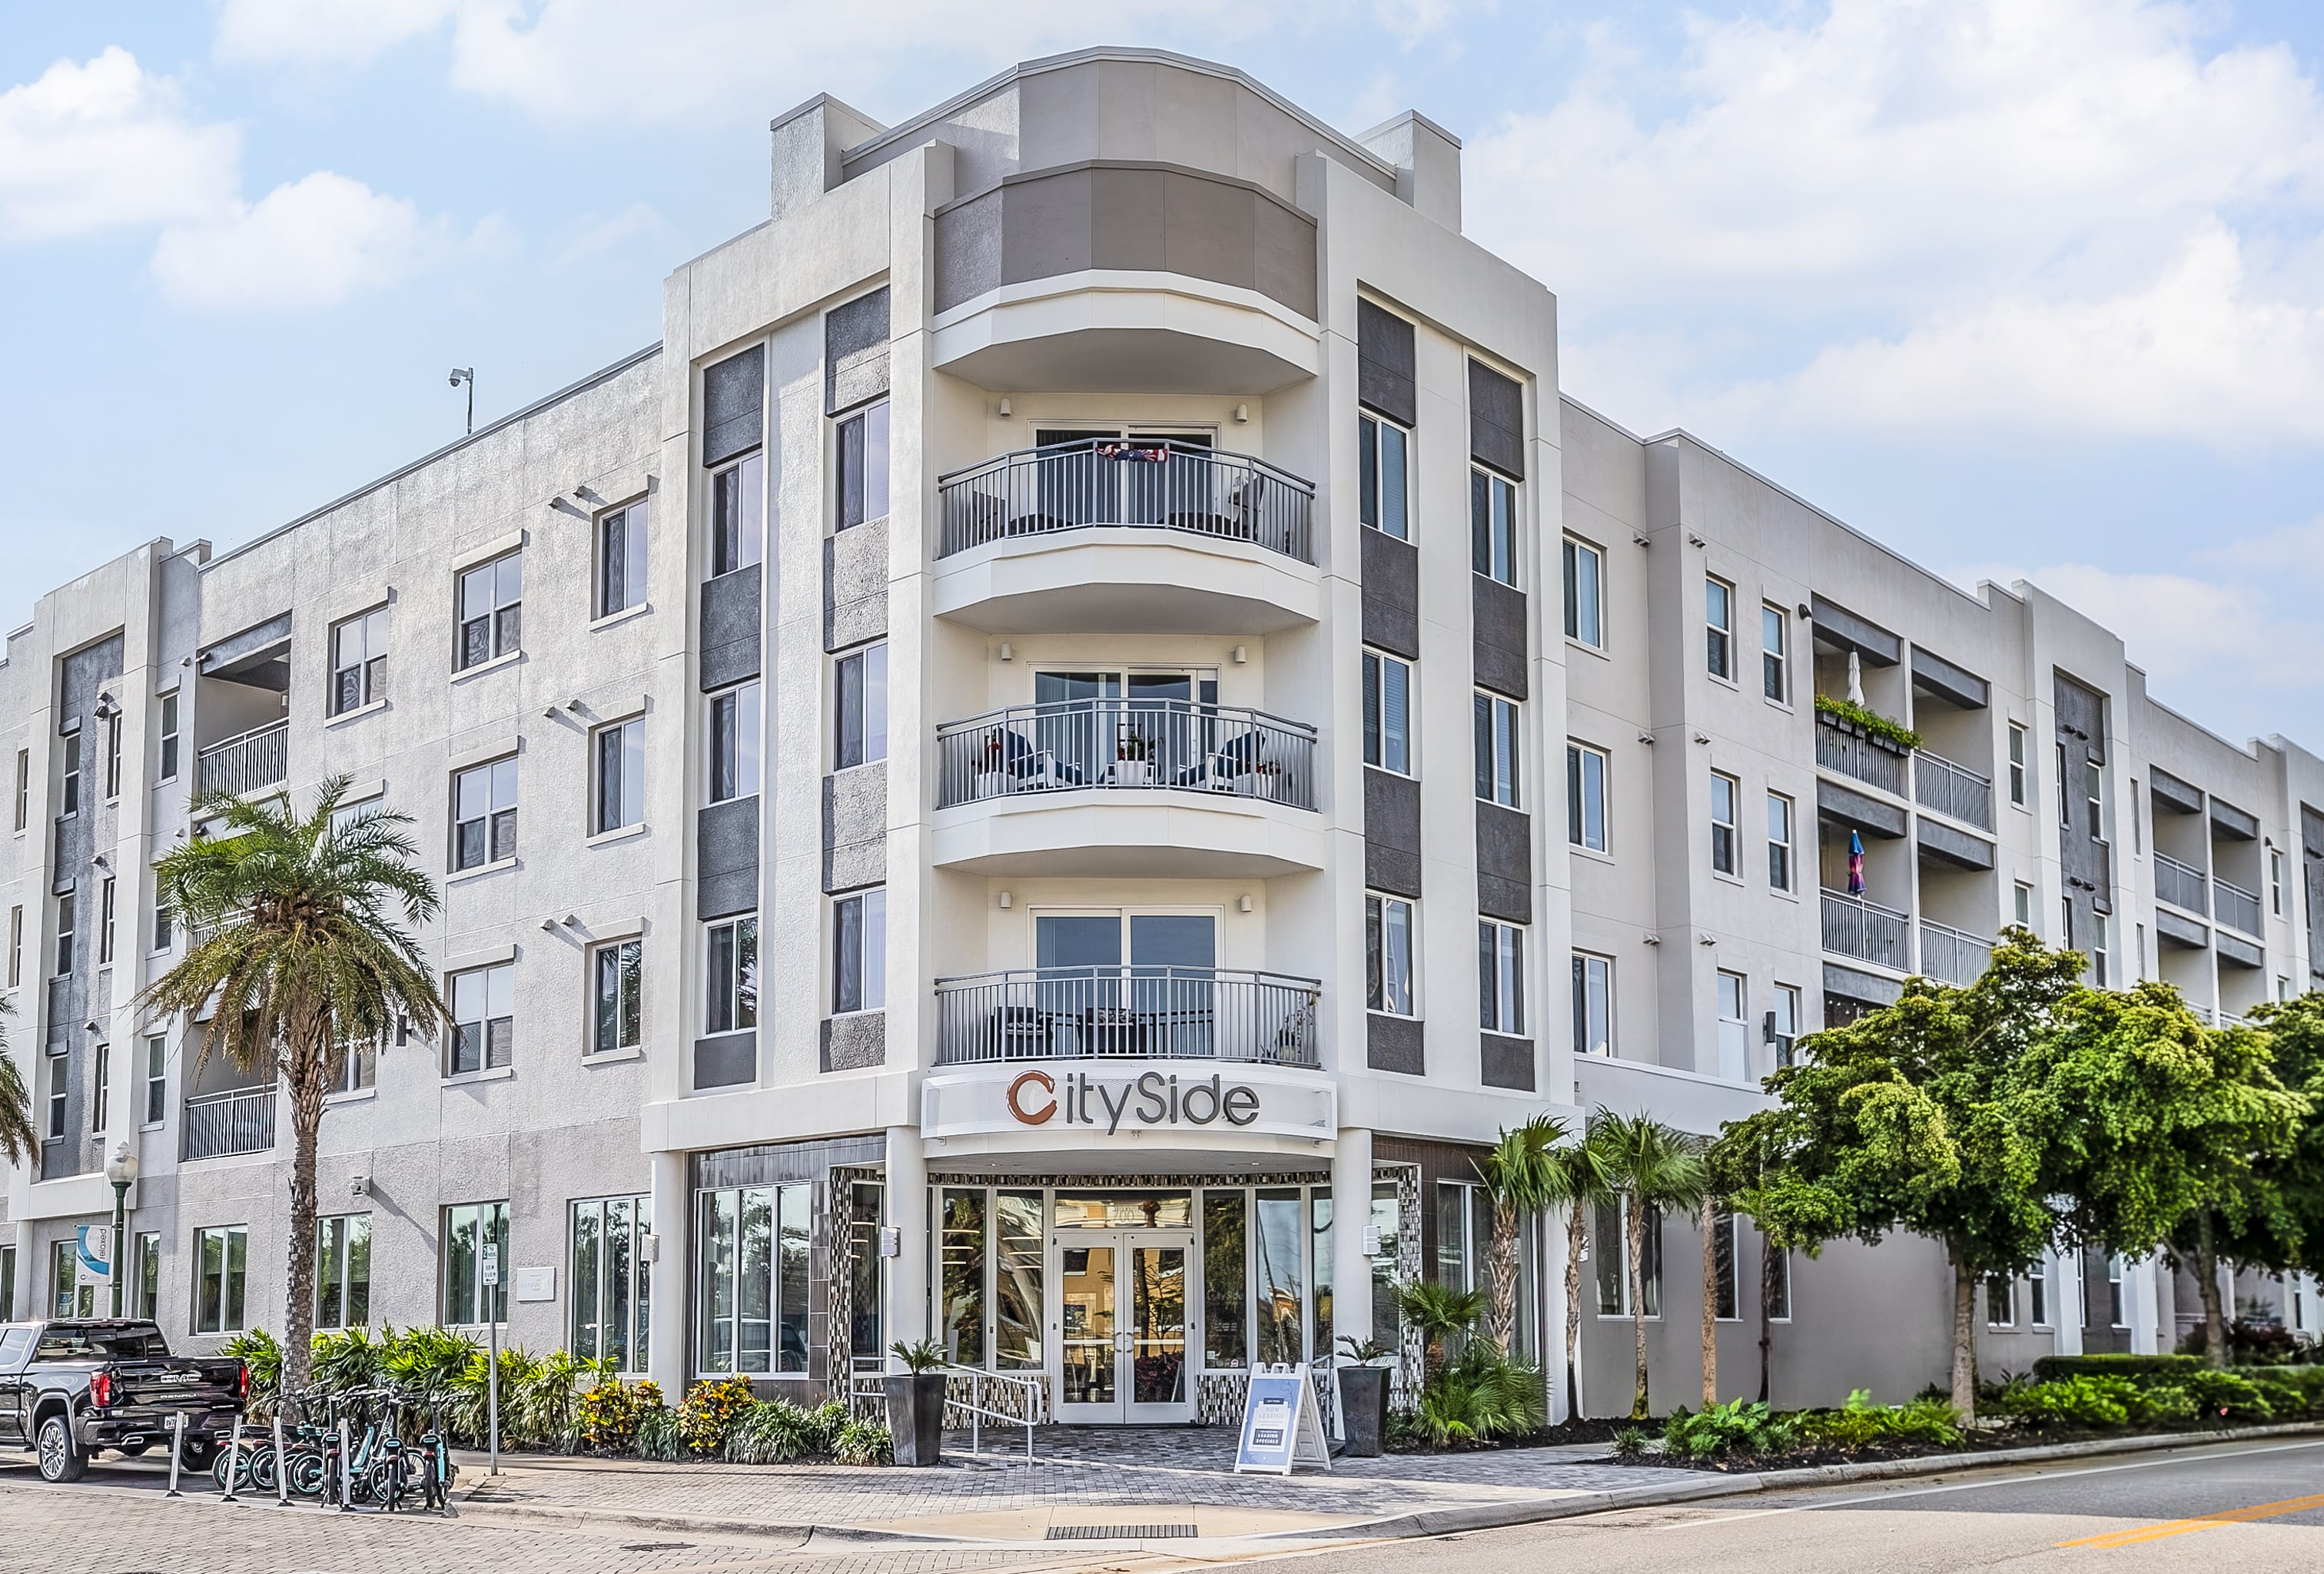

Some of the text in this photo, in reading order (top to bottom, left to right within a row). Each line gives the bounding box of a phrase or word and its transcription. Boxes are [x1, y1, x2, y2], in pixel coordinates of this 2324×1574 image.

[1007, 1070, 1260, 1136] CitySide
[98, 1228, 107, 1259] relaxed
[161, 1374, 201, 1383] GMC
